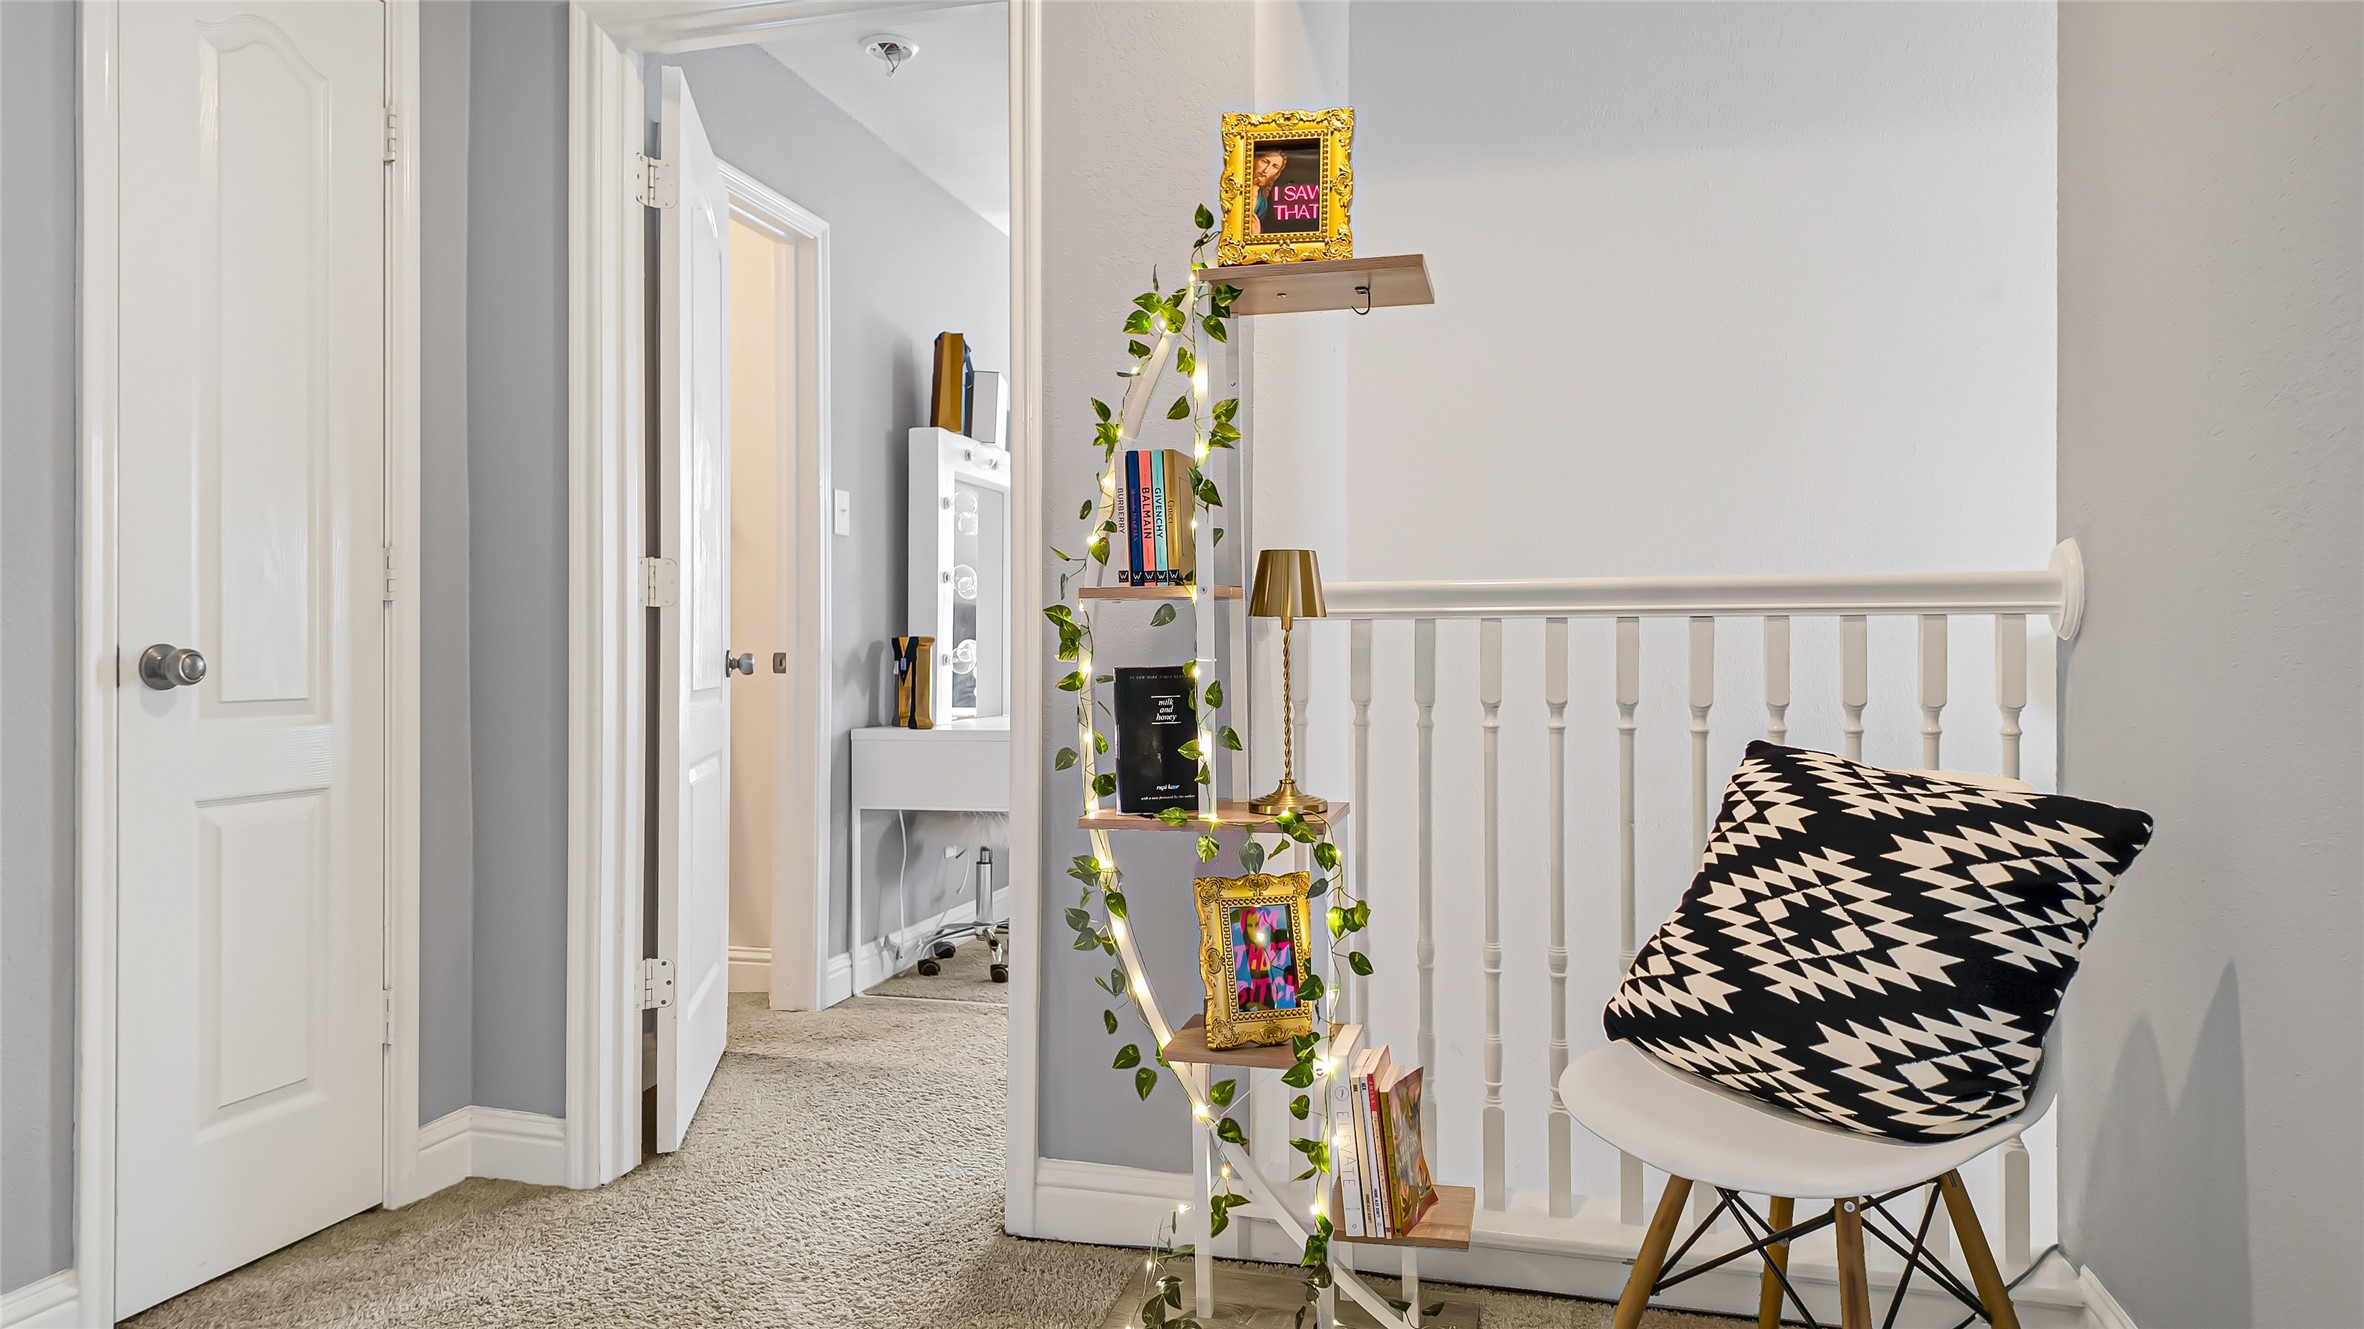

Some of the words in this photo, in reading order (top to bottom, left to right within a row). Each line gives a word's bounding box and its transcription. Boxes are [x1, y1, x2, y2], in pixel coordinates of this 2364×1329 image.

[1274, 186, 1279, 201] I
[1273, 203, 1319, 220] THAT
[1117, 487, 1125, 534] BURBERRY
[1141, 487, 1152, 539] BALMAIN
[1154, 487, 1163, 538] GIVENCHY
[1156, 713, 1177, 722] honey
[1159, 705, 1173, 713] and
[1336, 1111, 1357, 1187] ELEVATE
